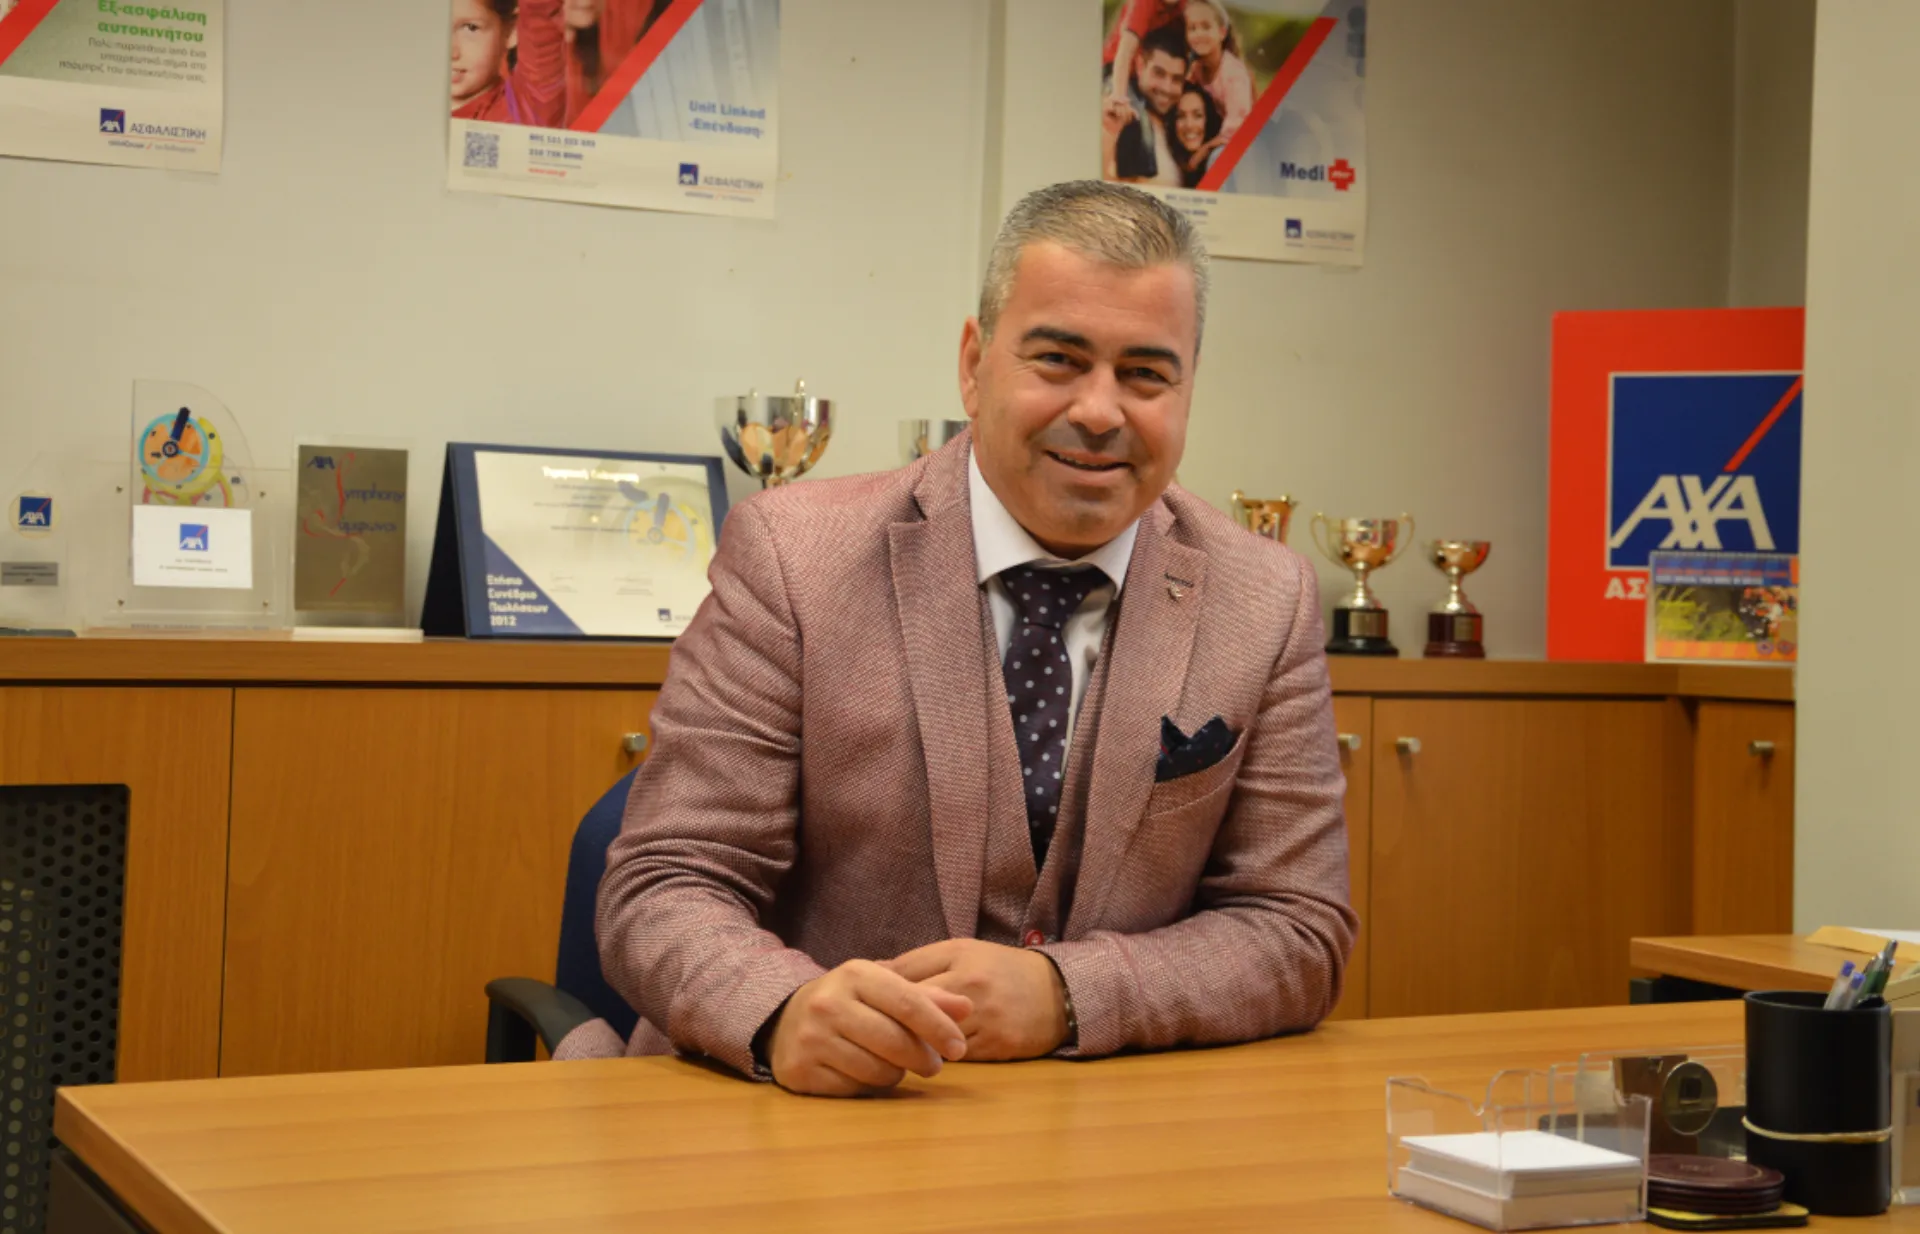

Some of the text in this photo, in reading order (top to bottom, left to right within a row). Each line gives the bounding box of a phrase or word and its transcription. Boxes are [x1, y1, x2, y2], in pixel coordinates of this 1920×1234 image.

[98, 22, 204, 42] αυτοκινήτου
[689, 100, 765, 120] Unit Linked
[1280, 162, 1325, 181] Medi
[1608, 475, 1776, 549] AXA
[1604, 577, 1649, 600] ΑΣ
[490, 615, 517, 627] 2012
